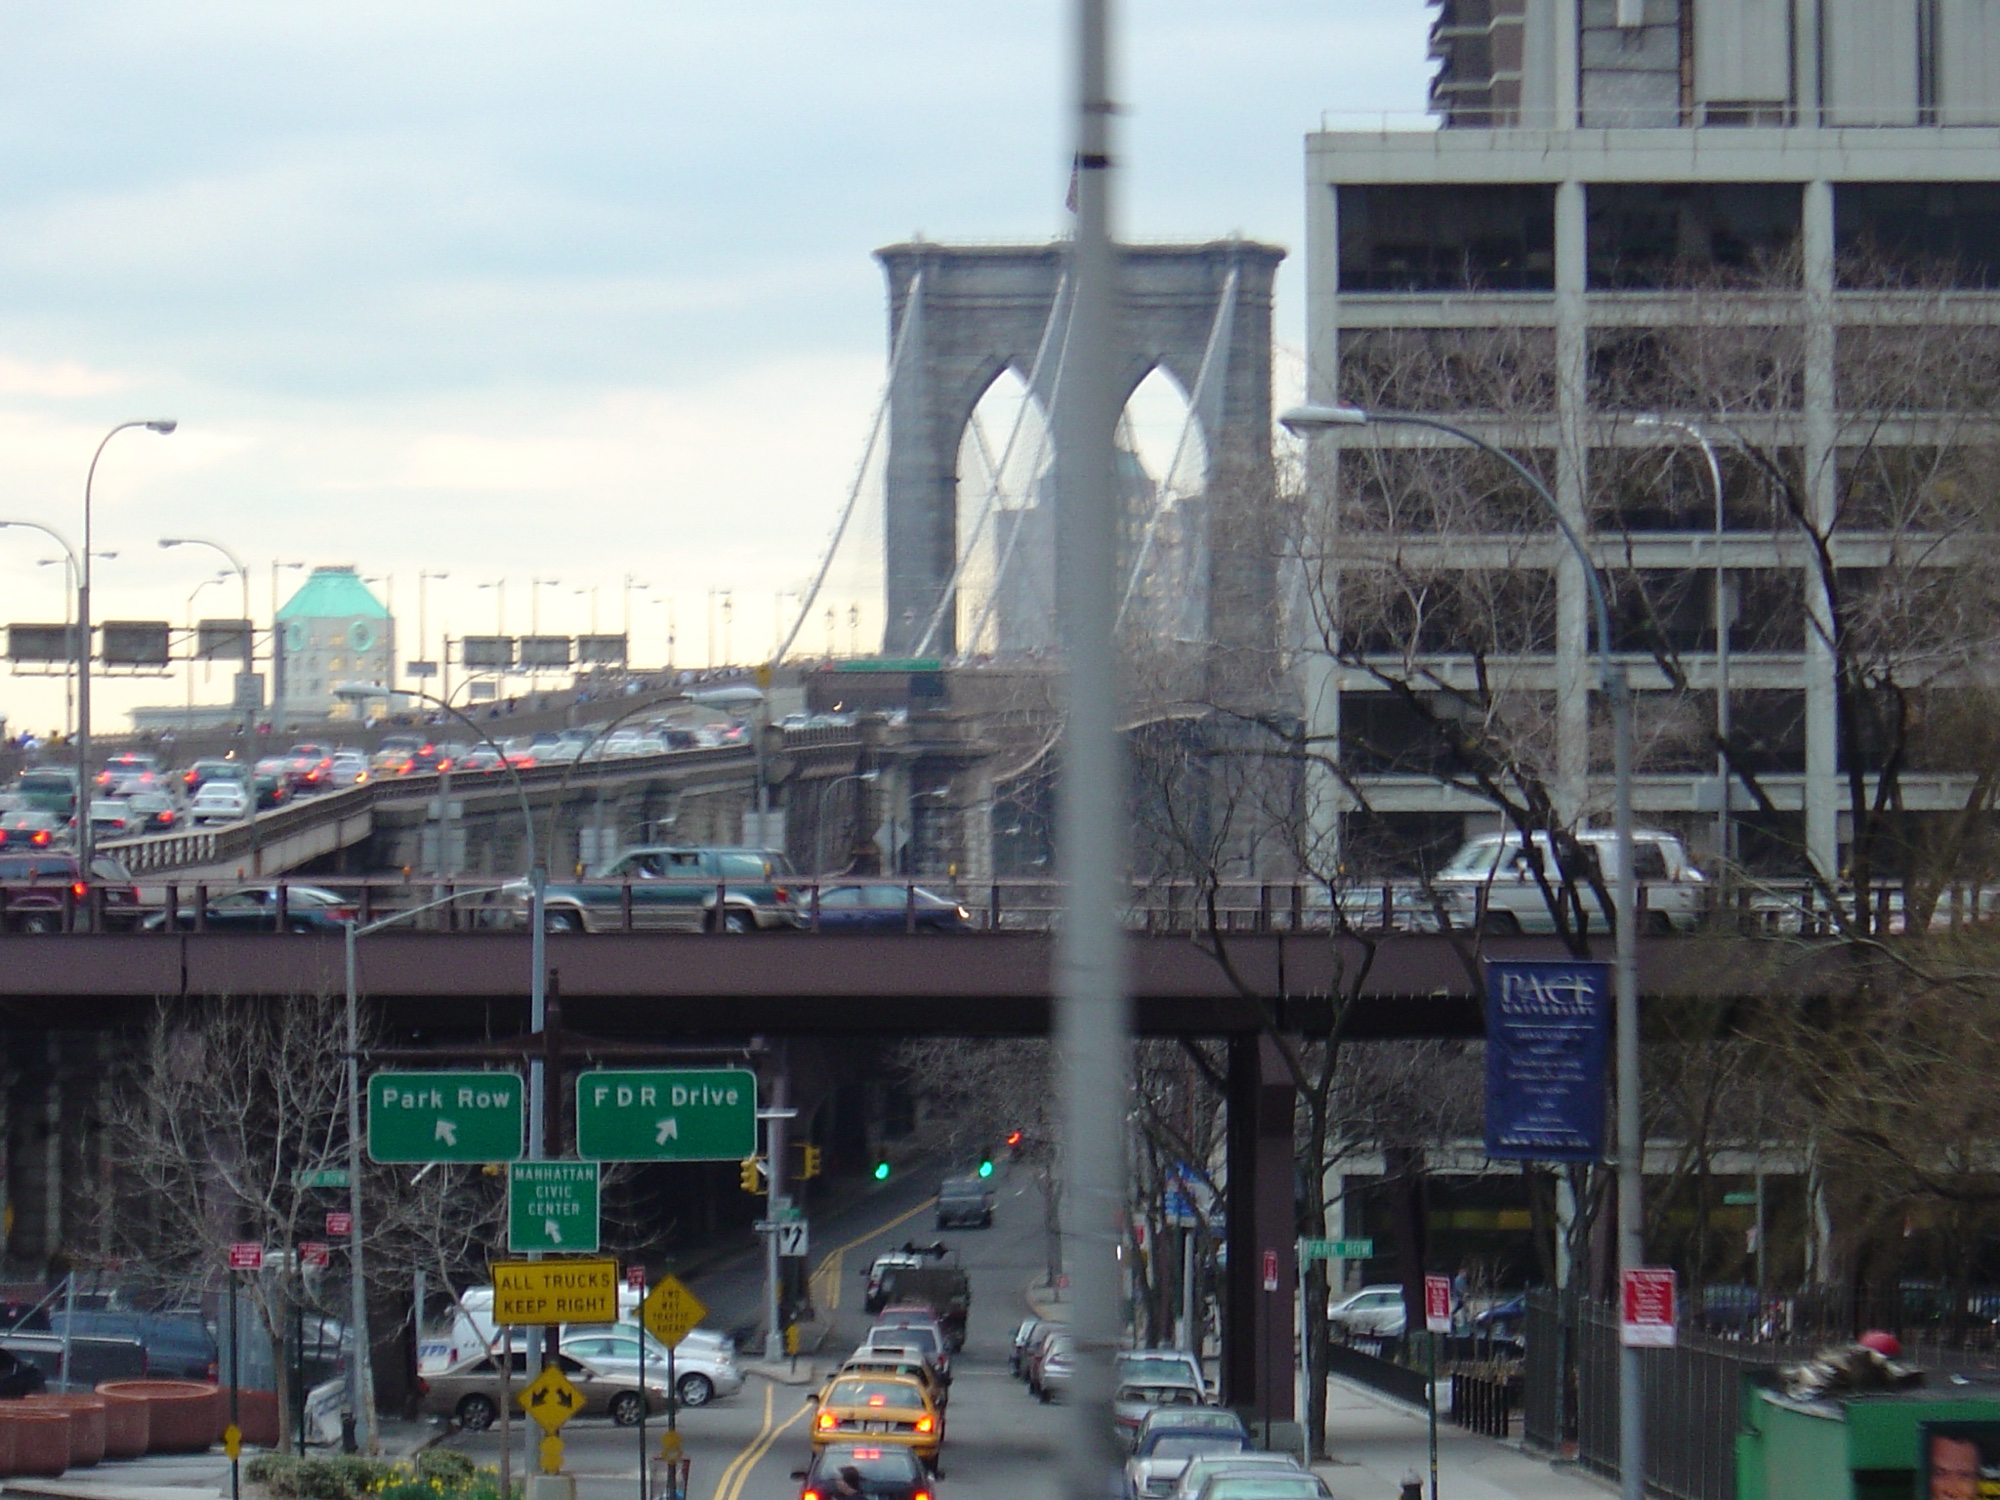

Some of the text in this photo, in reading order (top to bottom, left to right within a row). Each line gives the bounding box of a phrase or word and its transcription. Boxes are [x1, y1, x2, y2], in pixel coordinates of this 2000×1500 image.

[383, 1088, 510, 1108] Park Row
[671, 1085, 739, 1106] Drive
[514, 1168, 594, 1181] MANHATTAN
[535, 1185, 572, 1198] CIVIC
[528, 1203, 579, 1216] CENTER
[501, 1275, 532, 1290] ALL
[544, 1273, 611, 1289] TRUCKS
[503, 1297, 606, 1315] KEEP RIGHT
